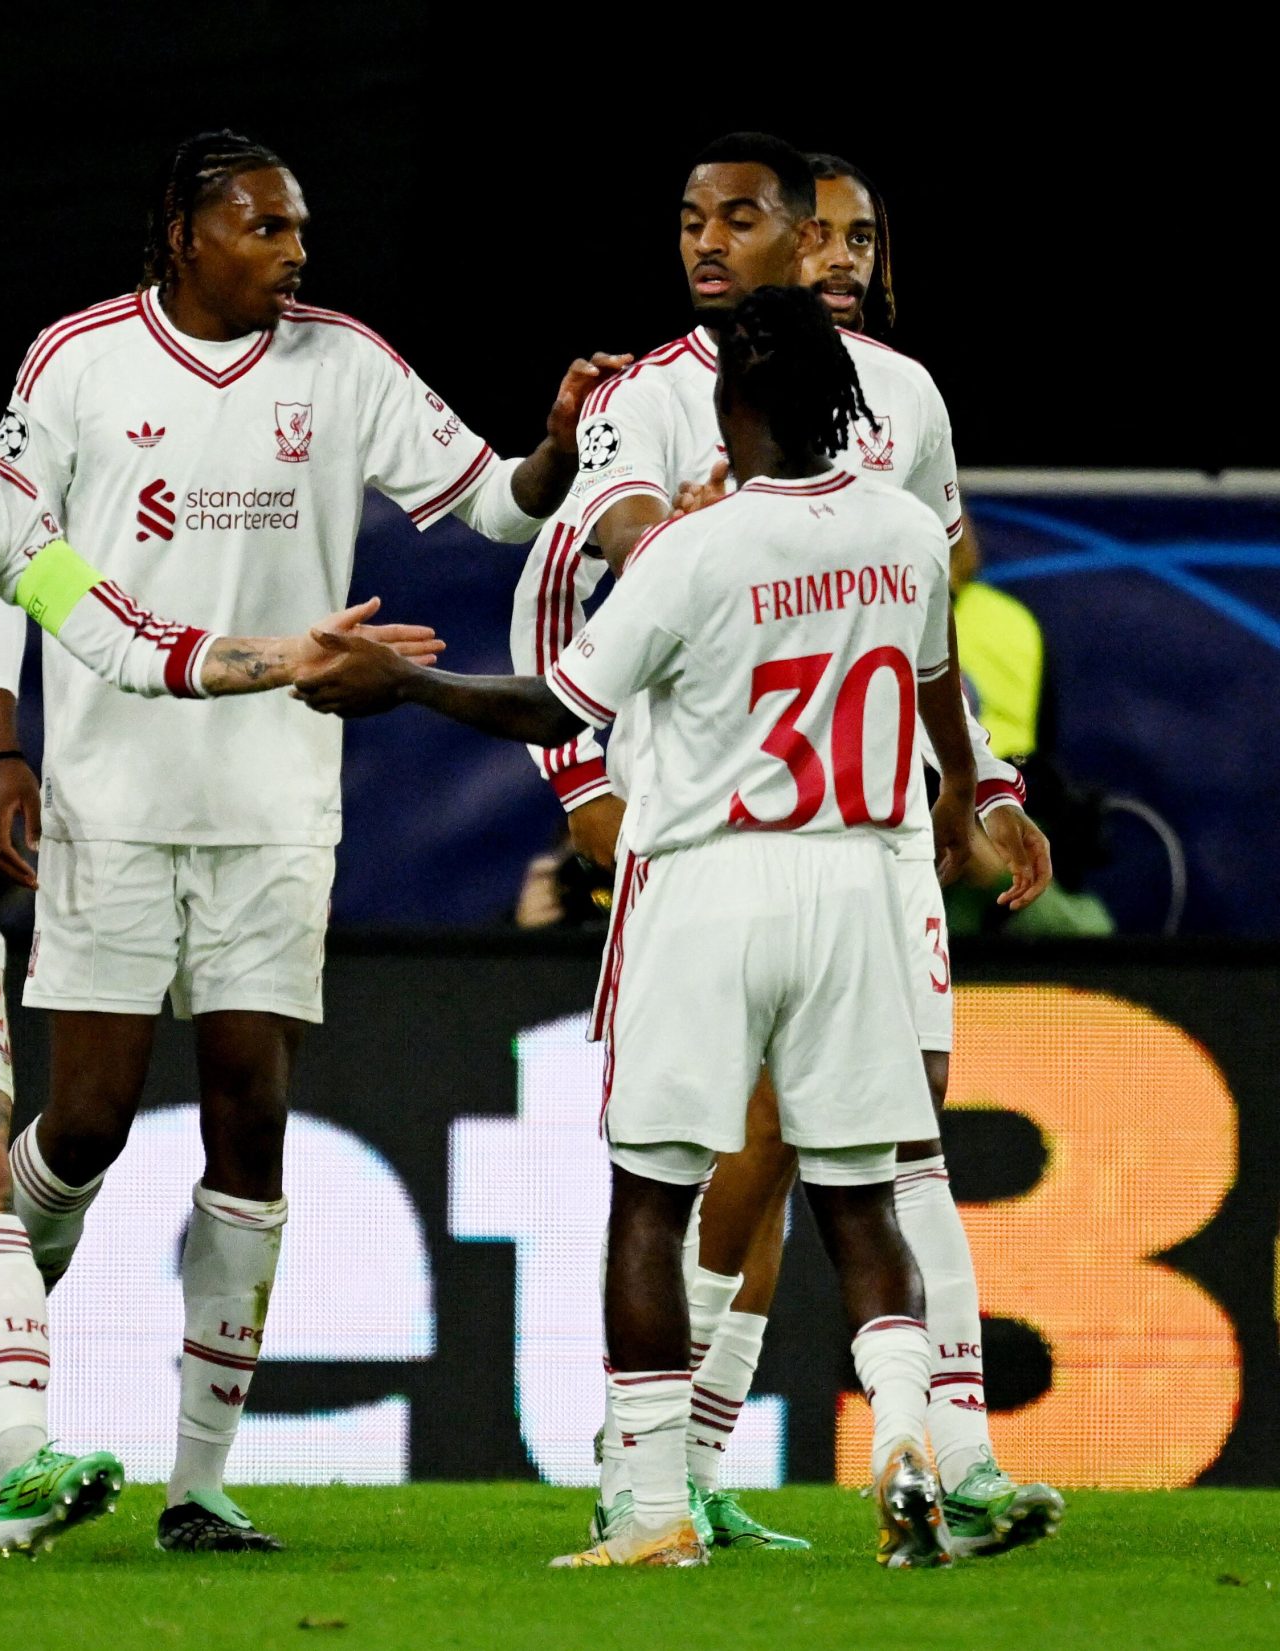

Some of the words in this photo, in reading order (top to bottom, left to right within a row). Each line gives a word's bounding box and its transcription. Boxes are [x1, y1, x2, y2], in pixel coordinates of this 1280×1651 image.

[185, 488, 296, 508] standard
[185, 510, 299, 531] chartered
[750, 564, 917, 625] FRIMPONG
[728, 645, 916, 832] 30
[5, 1317, 49, 1341] LFC
[938, 1342, 981, 1359] LFC
